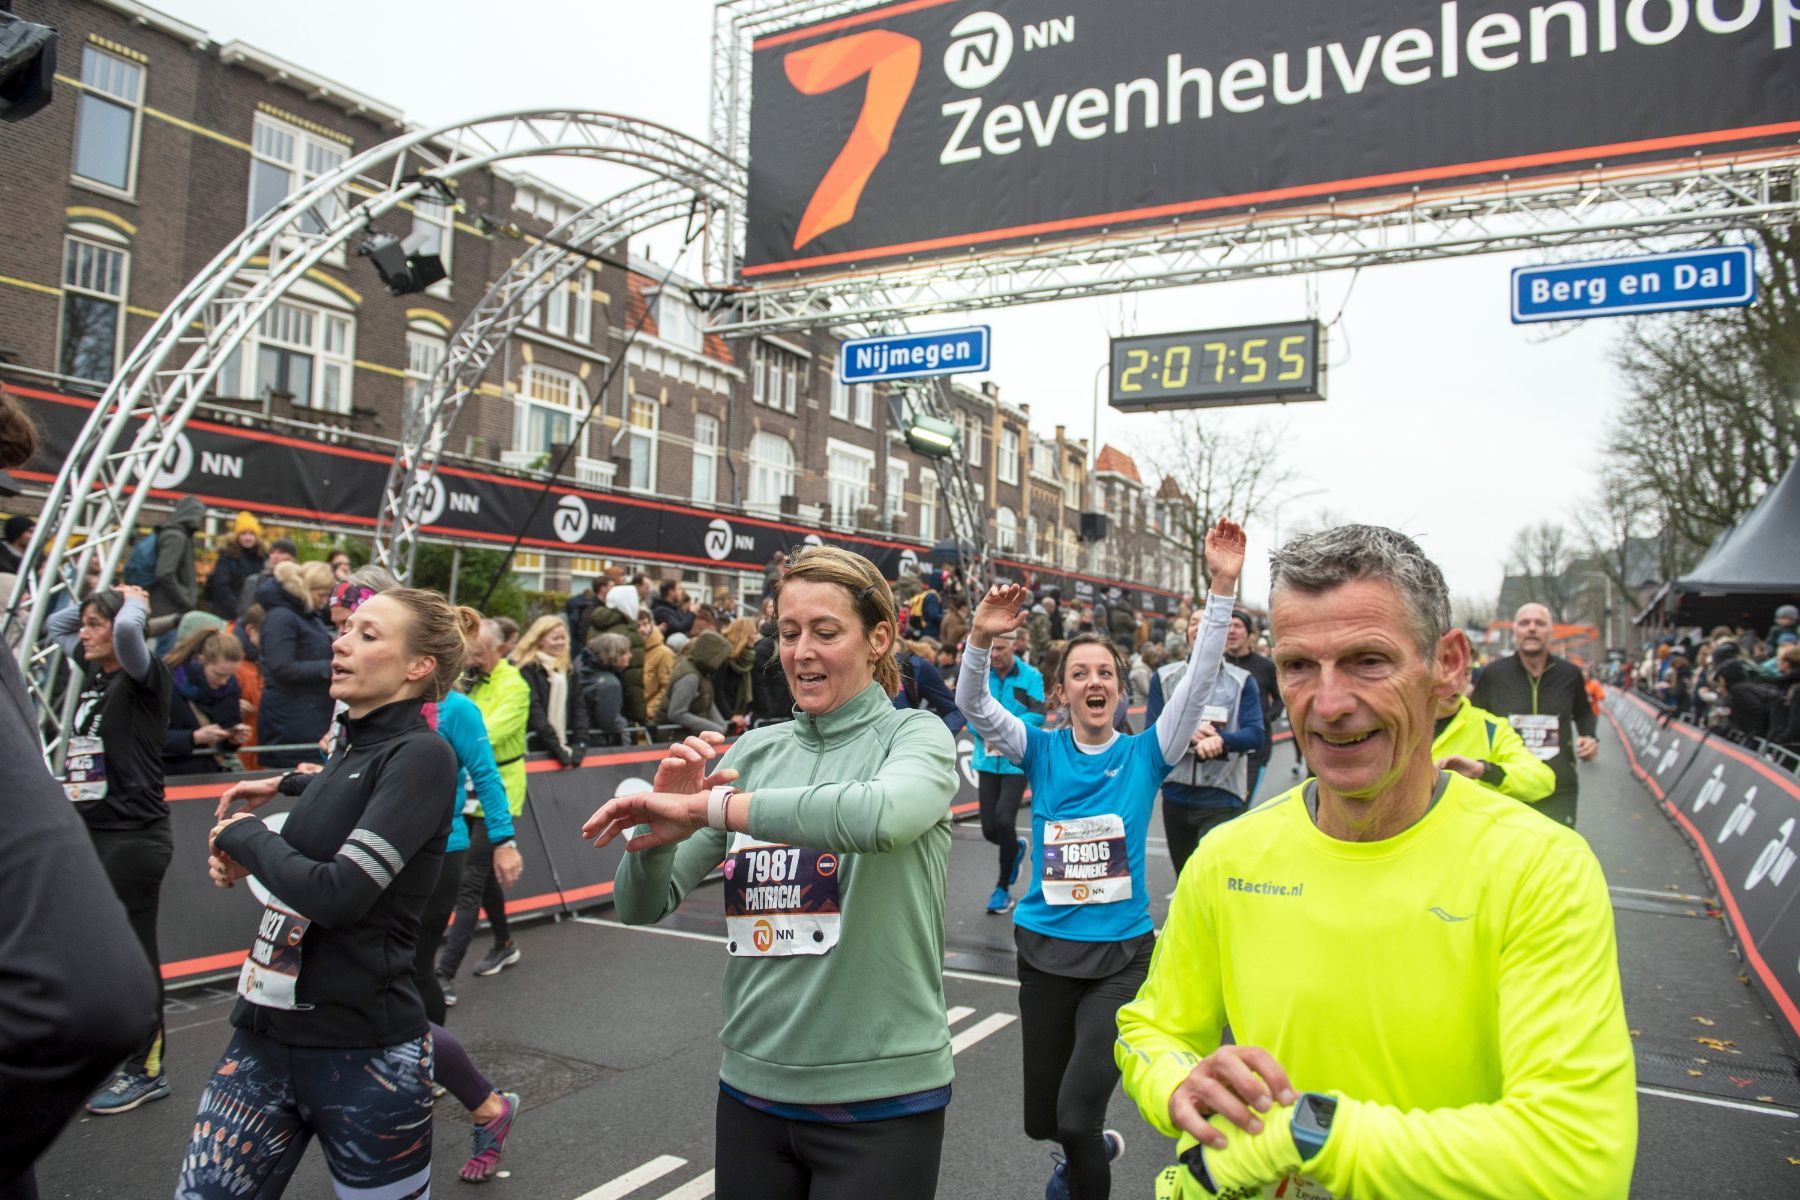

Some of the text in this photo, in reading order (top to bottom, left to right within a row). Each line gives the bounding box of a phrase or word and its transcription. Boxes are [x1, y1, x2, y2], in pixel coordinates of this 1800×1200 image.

[1023, 15, 1075, 52] NN
[1531, 260, 1732, 305] Berg en Dal
[856, 341, 970, 373] Nijmegen
[1120, 335, 1306, 392] 2:07:55
[201, 450, 243, 479] NN
[450, 491, 480, 514] NN
[592, 513, 616, 532] NN
[734, 534, 755, 551] NN
[1060, 841, 1111, 863] 16906
[745, 848, 801, 883] 7987
[1046, 867, 1053, 875] R
[745, 885, 801, 911] PATRICIA
[1092, 887, 1104, 895] NN
[1227, 877, 1304, 897] REactive.nl
[775, 929, 794, 939] NN
